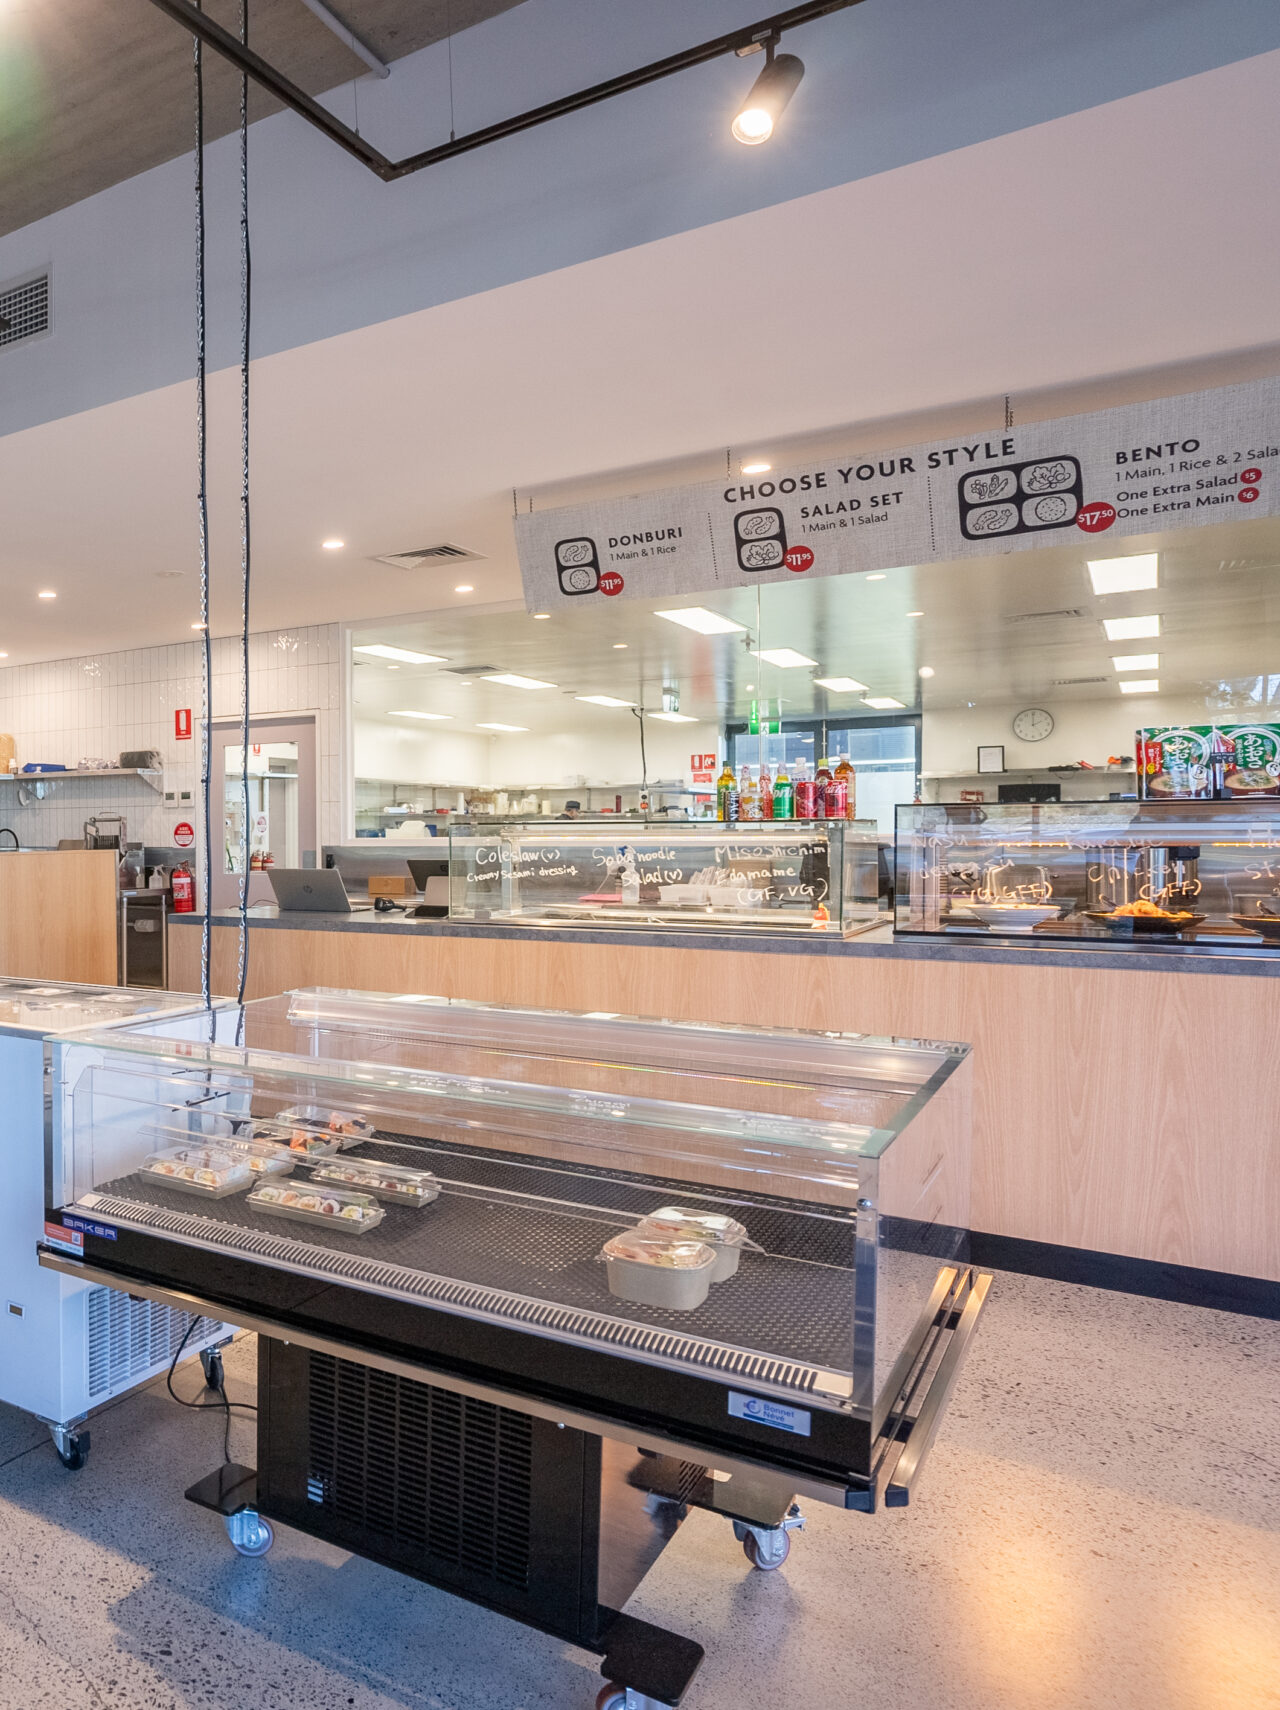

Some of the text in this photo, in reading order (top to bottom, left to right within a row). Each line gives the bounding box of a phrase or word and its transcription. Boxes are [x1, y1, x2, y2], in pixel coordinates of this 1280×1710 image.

[1116, 439, 1200, 465] BENTO
[724, 438, 1016, 503] CHOOSE YOUR STYLE
[1115, 446, 1280, 482] 1 Main, 1 Rice & 2 Sala
[1245, 472, 1256, 480] $5
[1116, 472, 1238, 502] One Extra Salad
[1242, 490, 1254, 499] $6
[800, 491, 904, 519] SALAD SET
[1117, 493, 1234, 518] One Extra Main
[802, 511, 889, 534] 1 Main & 1 Salad
[1078, 509, 1114, 526] $17.50
[608, 526, 683, 548] DONBURI
[609, 545, 677, 561] 1 Main & 1 Rice
[786, 553, 812, 566] $11.95
[600, 578, 622, 591] $11.95
[637, 846, 676, 862] noodle
[467, 871, 500, 882] Creamy
[539, 865, 578, 876] dressing
[63, 1218, 116, 1238] BAKER
[763, 1403, 794, 1418] Bonnet
